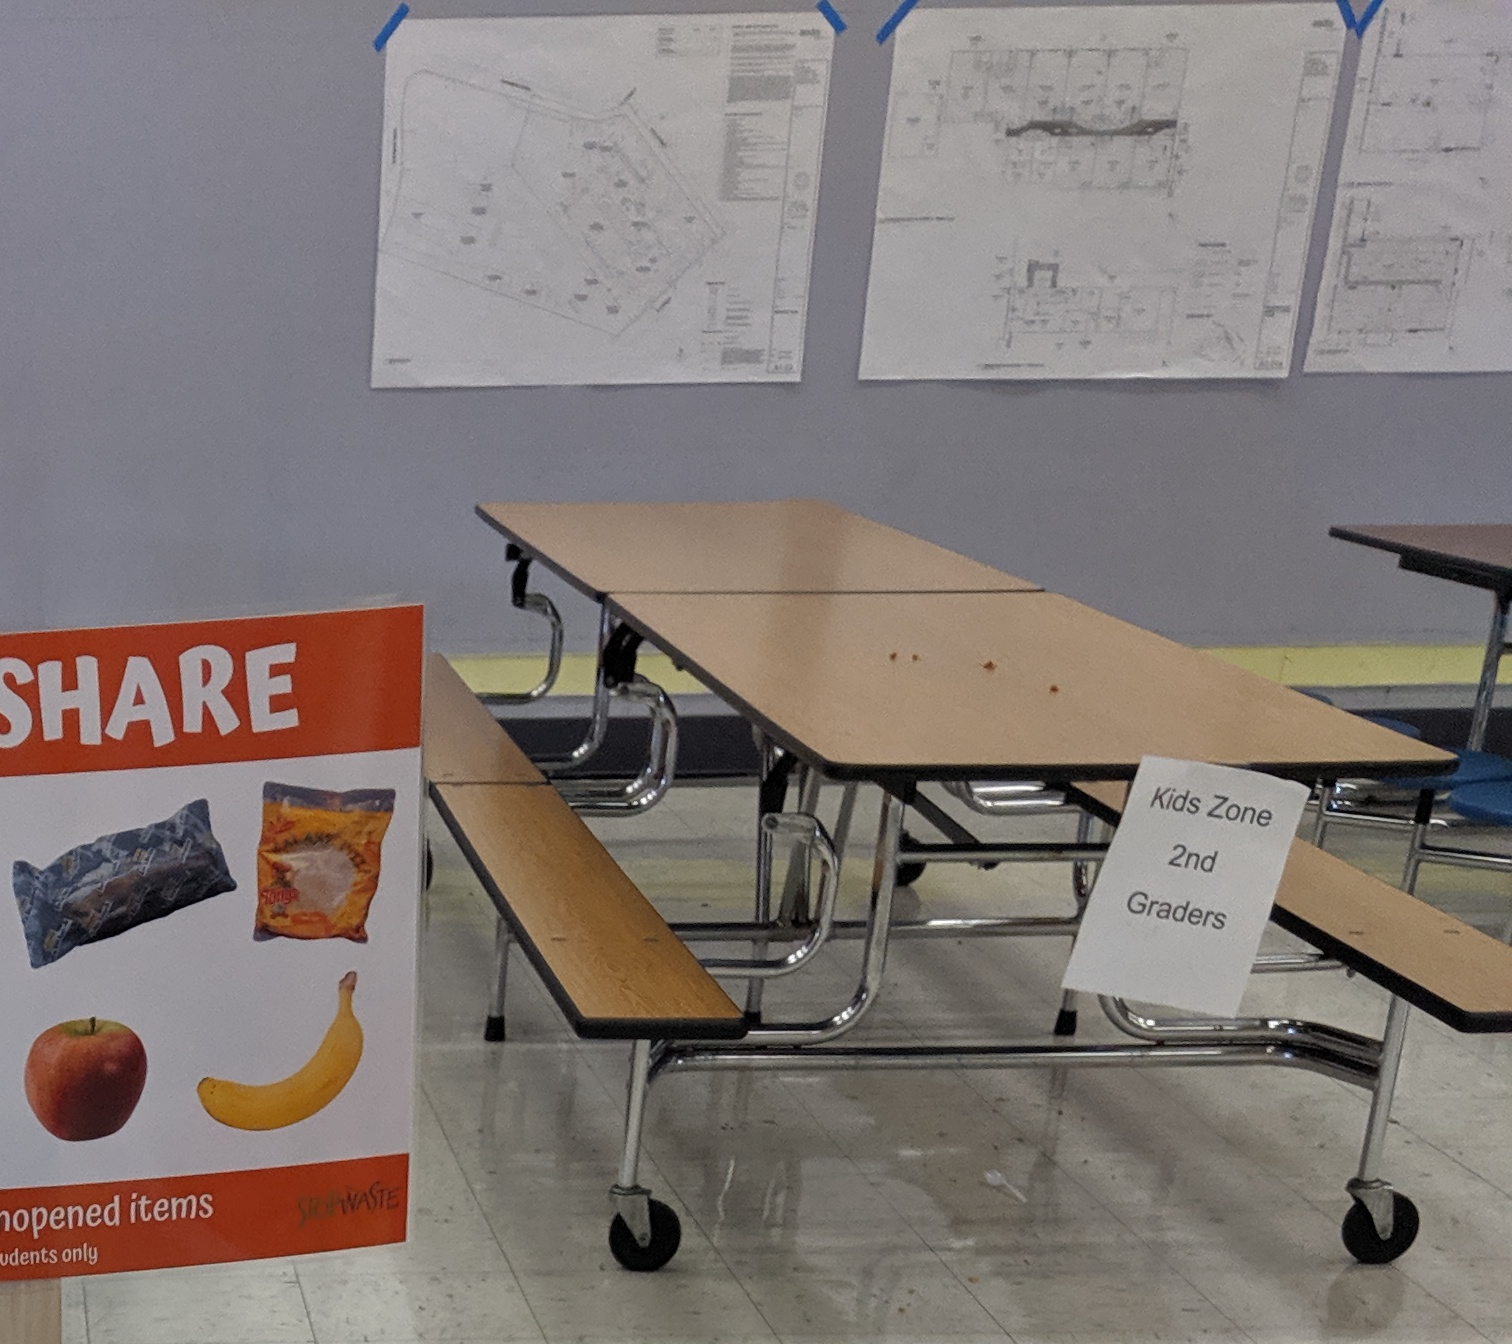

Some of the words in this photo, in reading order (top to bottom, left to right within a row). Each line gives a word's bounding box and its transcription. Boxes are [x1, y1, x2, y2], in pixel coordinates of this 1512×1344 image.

[1149, 786, 1202, 816] Kids
[1206, 794, 1274, 828] Zone
[1167, 843, 1220, 874] 2nd
[1126, 890, 1228, 931] Graders
[129, 1190, 215, 1225] items
[62, 1242, 100, 1266] only
